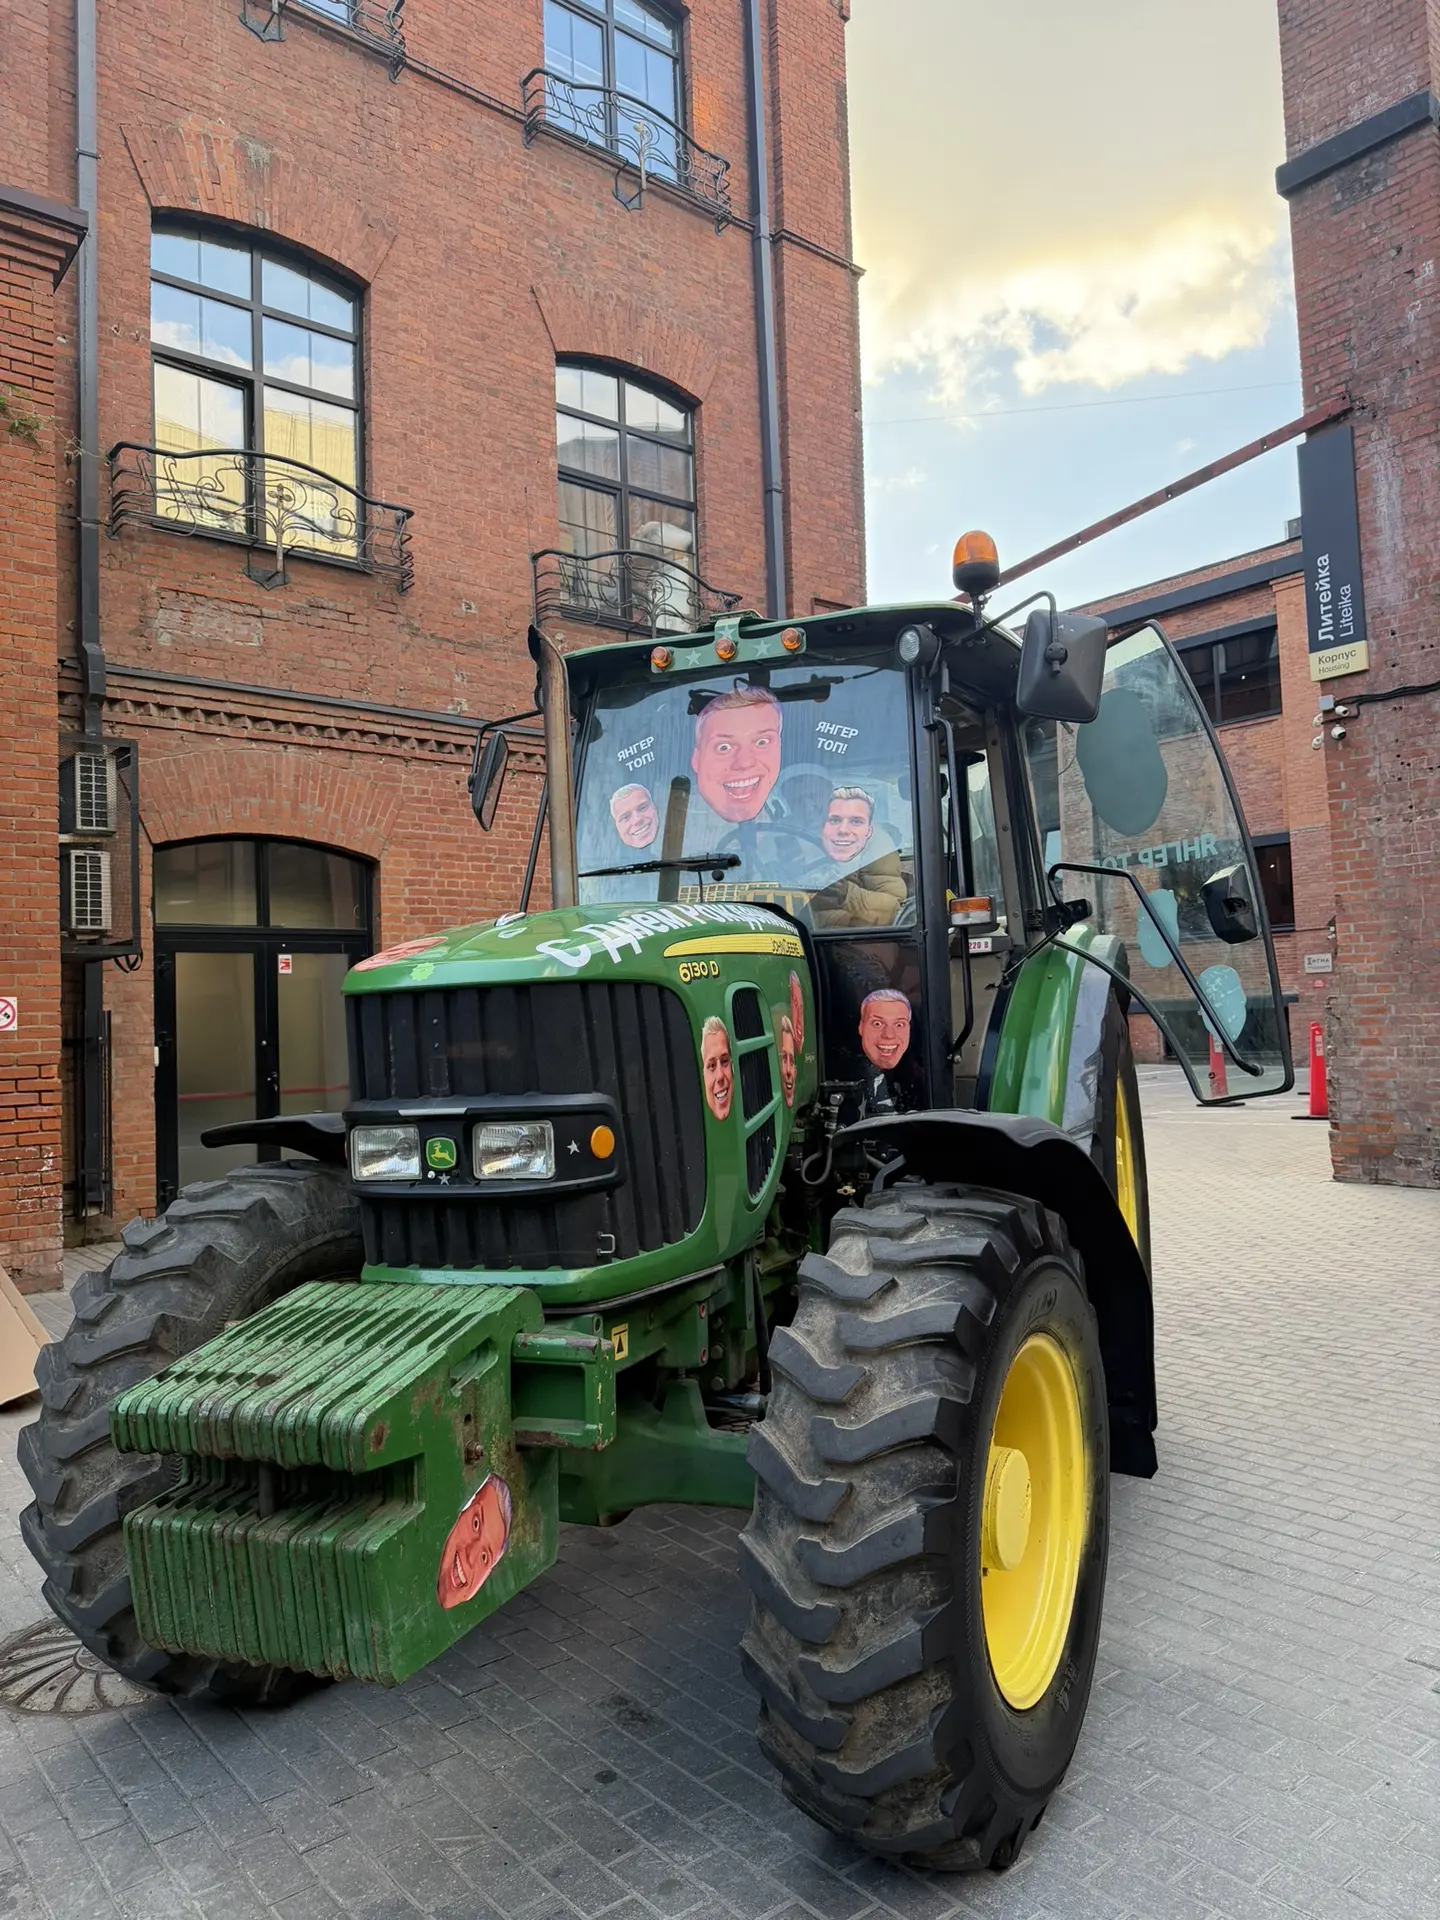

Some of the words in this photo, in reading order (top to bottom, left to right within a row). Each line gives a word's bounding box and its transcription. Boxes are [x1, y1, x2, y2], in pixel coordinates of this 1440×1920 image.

[1315, 554, 1334, 641] Литейка
[1338, 583, 1354, 637] Liteika
[1318, 649, 1357, 665] Корпус
[1318, 662, 1350, 675] Housing
[815, 721, 859, 739] ЯНГЕР
[617, 736, 655, 762] ЯНГЕР
[817, 737, 848, 755] ТОП!
[625, 751, 655, 772] ТОП!
[679, 961, 709, 984] 6130
[709, 960, 720, 977] D
